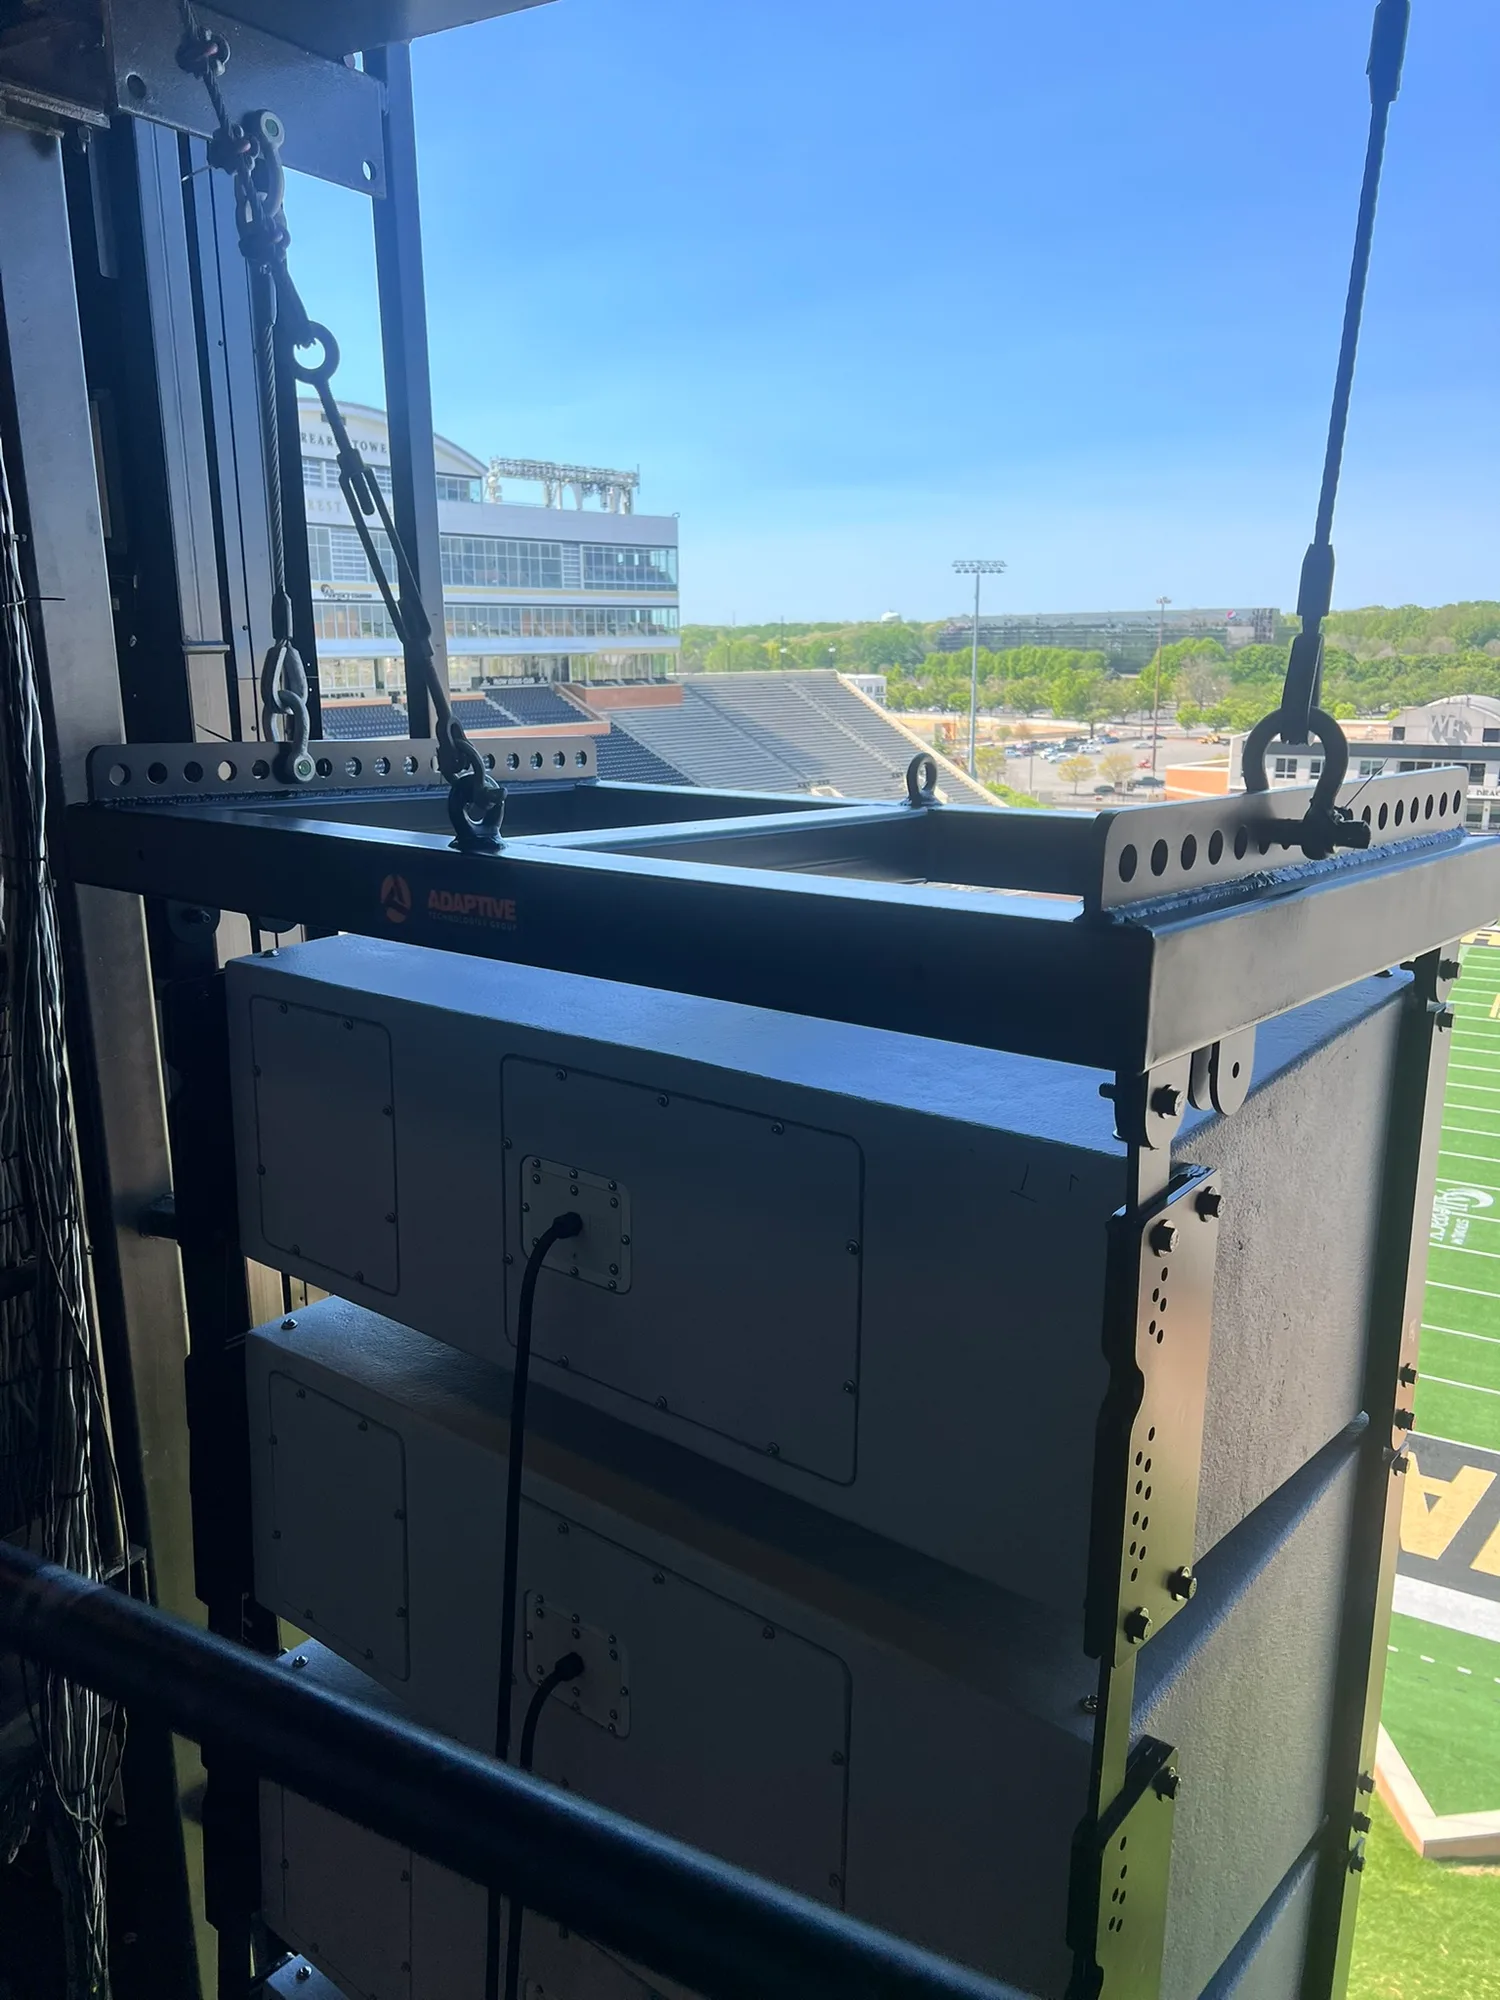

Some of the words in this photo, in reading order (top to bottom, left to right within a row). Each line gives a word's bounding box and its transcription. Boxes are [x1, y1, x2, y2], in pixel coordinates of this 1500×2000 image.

[300, 432, 335, 447] REAR
[351, 440, 388, 454] TOWE
[307, 499, 342, 513] REST
[428, 889, 517, 921] ADAPTIVE
[489, 920, 518, 932] GROUP
